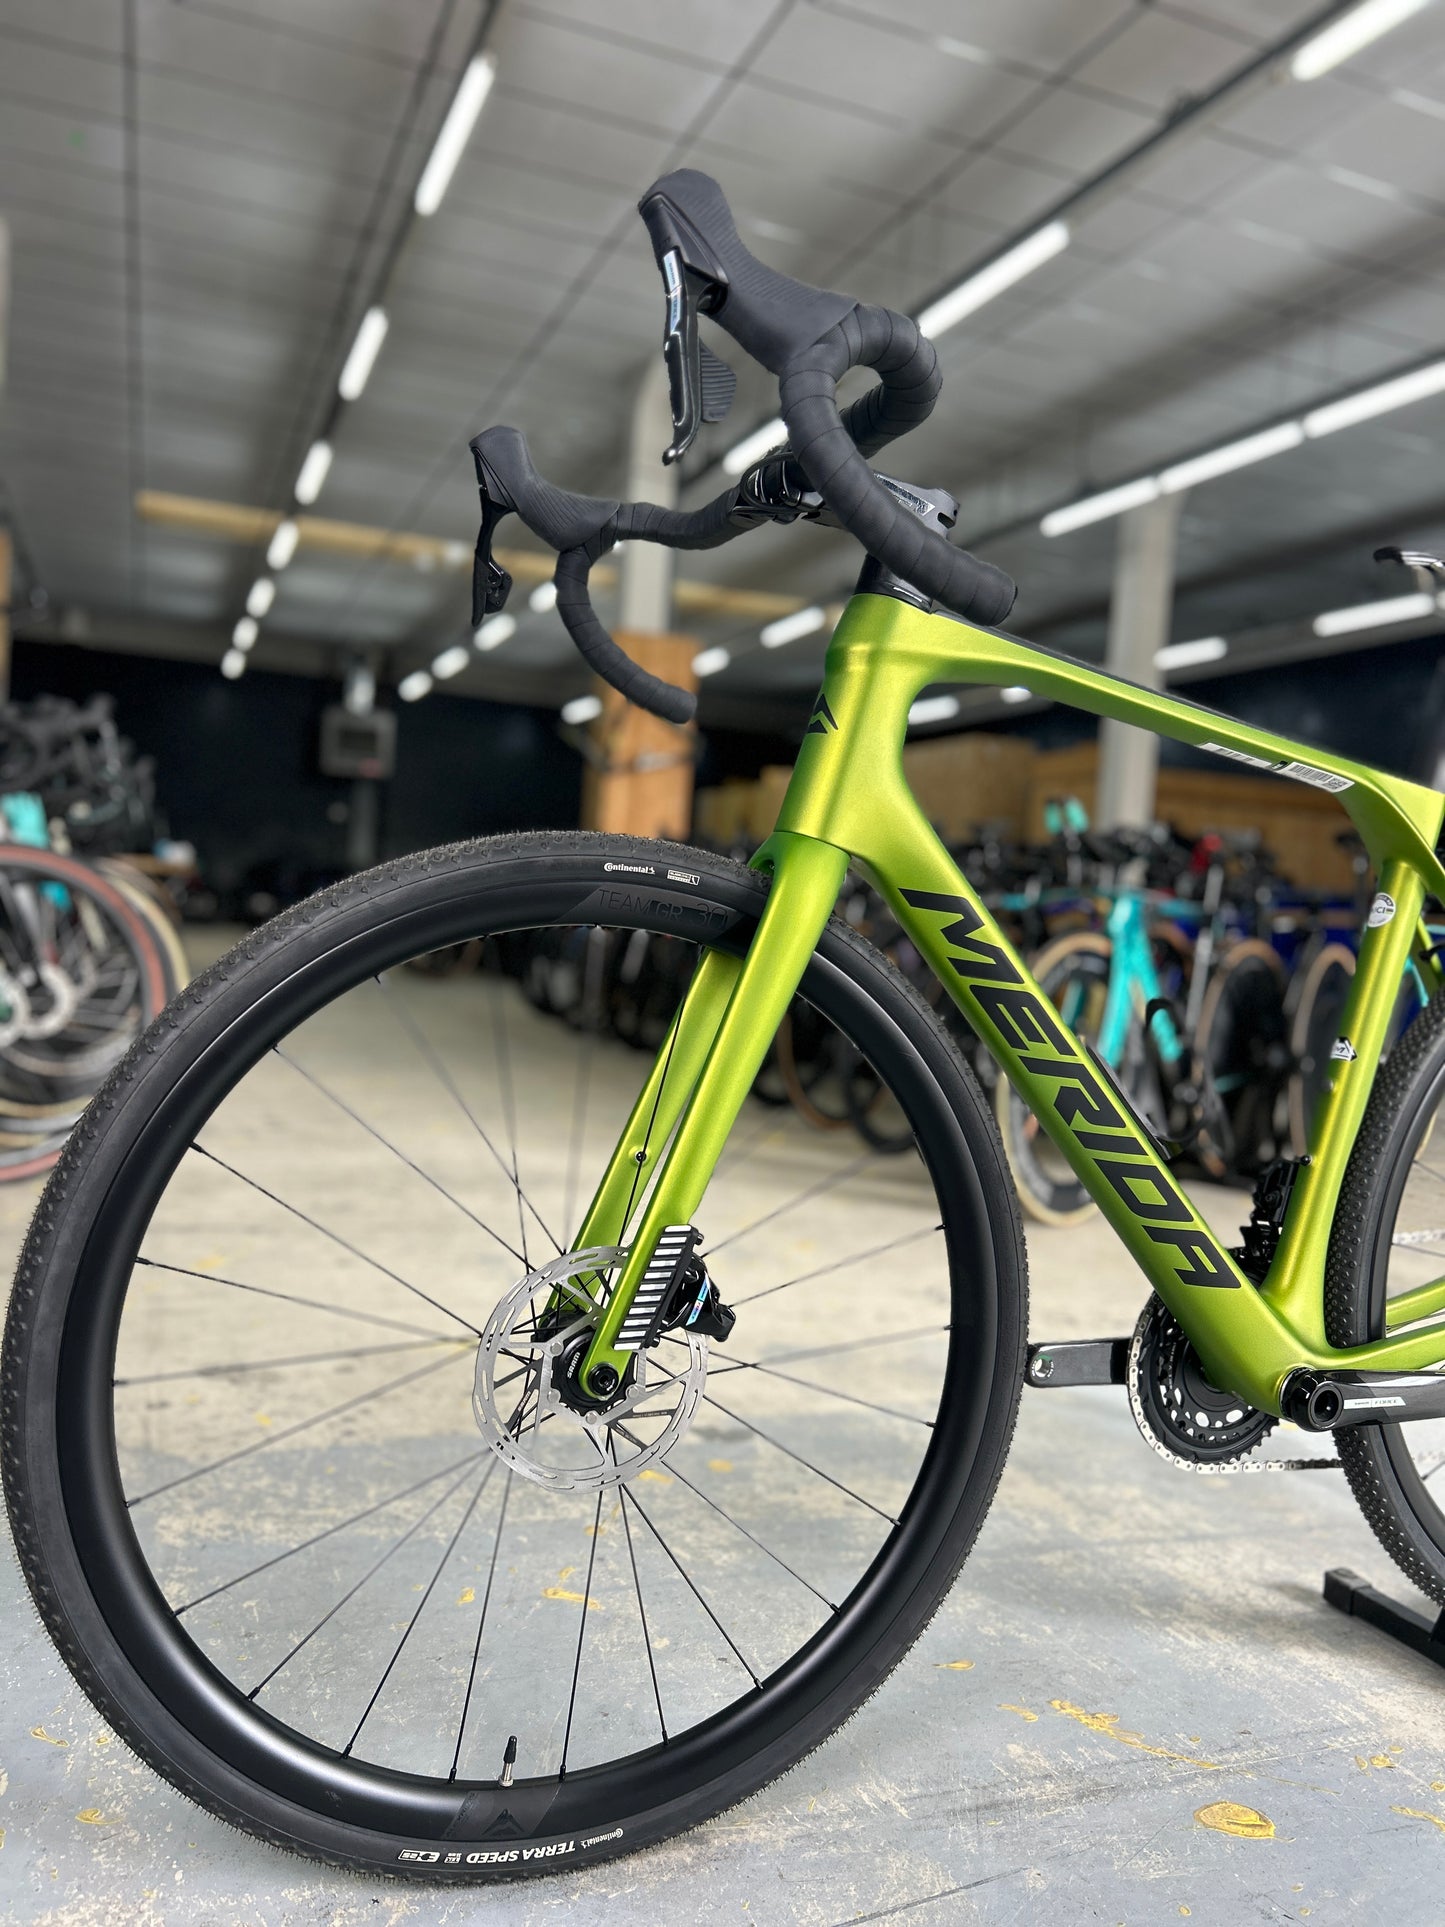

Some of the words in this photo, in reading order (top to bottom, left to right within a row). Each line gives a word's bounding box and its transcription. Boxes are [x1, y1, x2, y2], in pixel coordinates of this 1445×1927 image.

[603, 862, 649, 874] Continental
[598, 889, 651, 913] TEAM
[655, 902, 683, 921] GR
[696, 902, 729, 929] 30
[897, 887, 1242, 1288] MERIDA
[566, 1351, 581, 1379] SRAM
[588, 1827, 624, 1845] Continental
[467, 1849, 520, 1864] SPEED
[522, 1840, 575, 1862] TERRA
